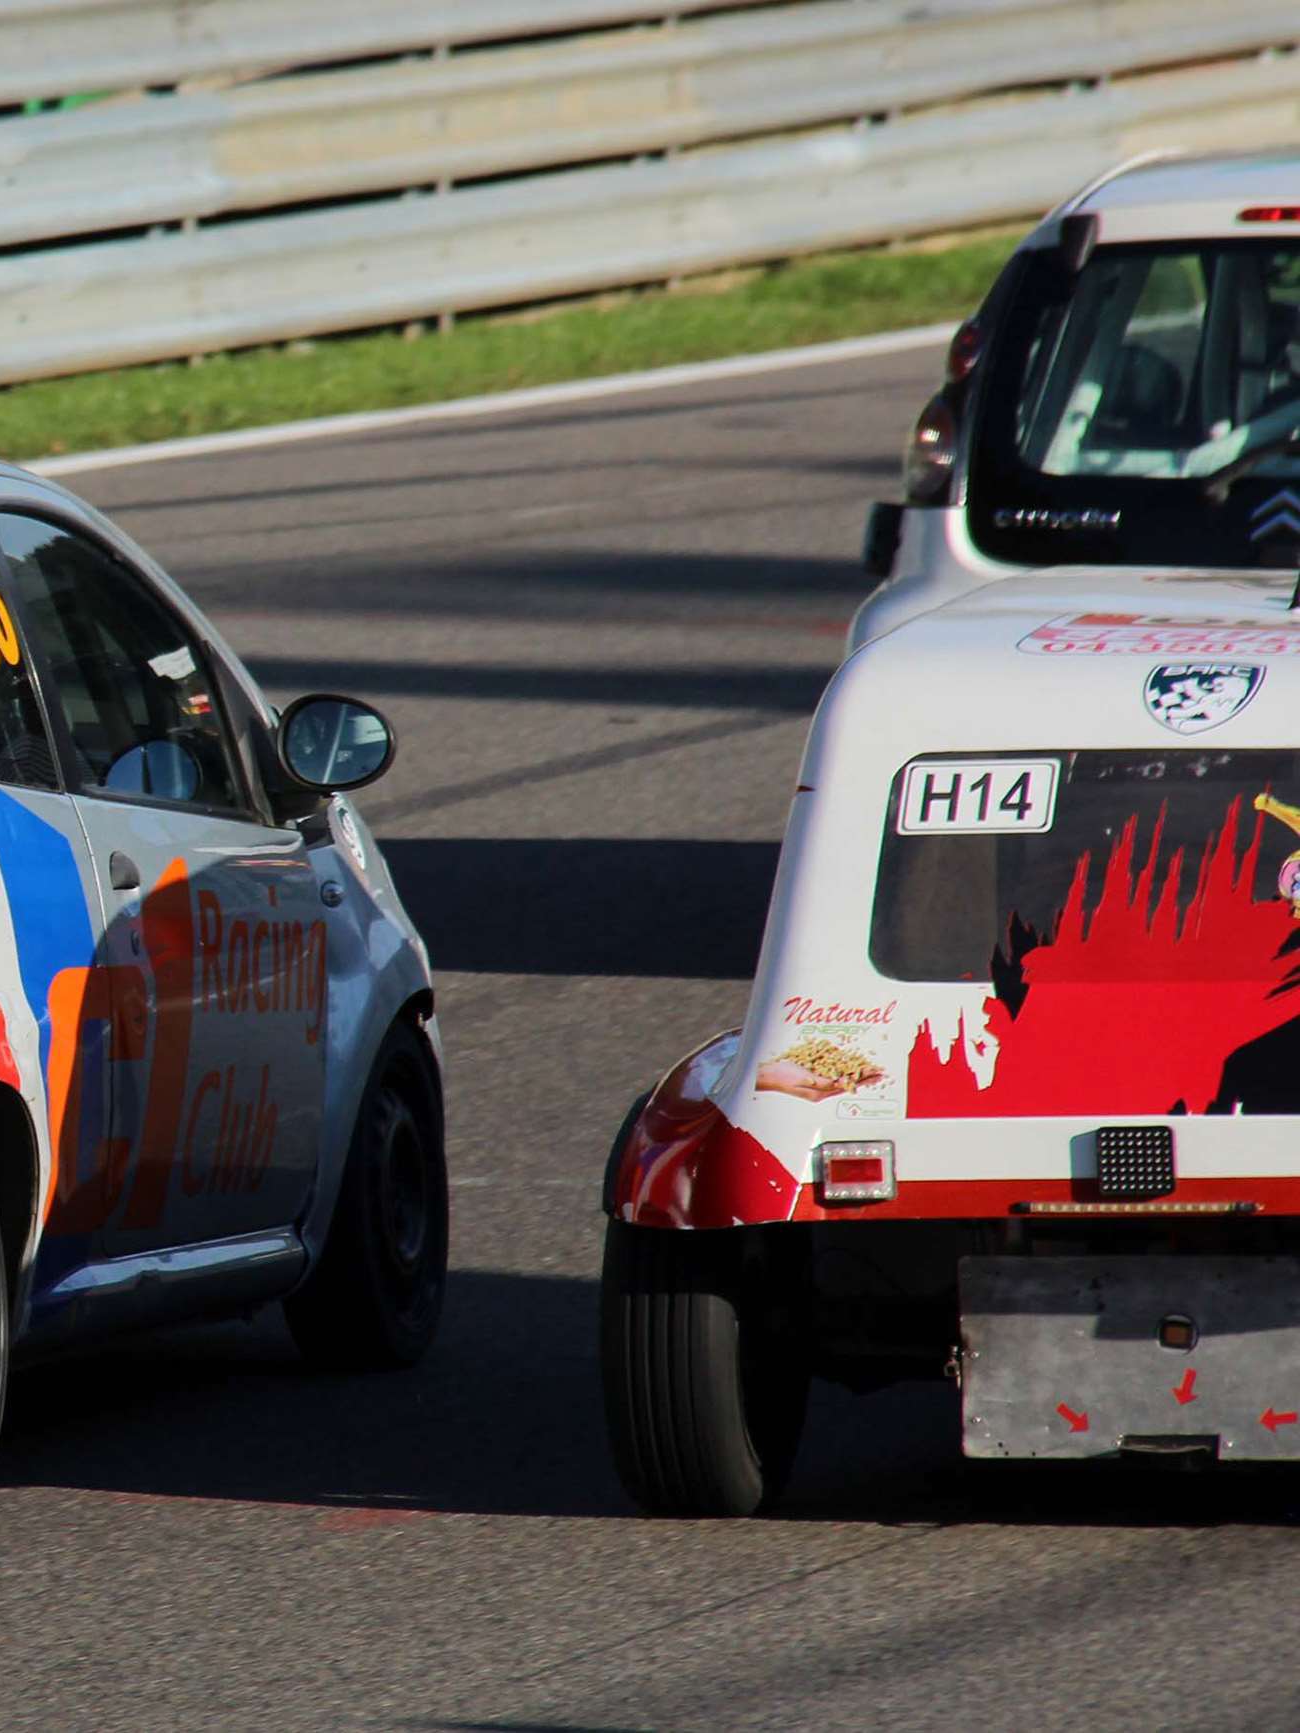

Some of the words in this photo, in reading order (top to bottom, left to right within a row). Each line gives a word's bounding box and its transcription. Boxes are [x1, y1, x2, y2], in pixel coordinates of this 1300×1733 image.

[1162, 664, 1251, 677] BARC
[919, 772, 1035, 822] H14
[197, 884, 328, 1046] Racing
[783, 996, 898, 1025] Natural
[182, 1064, 279, 1195] Club
